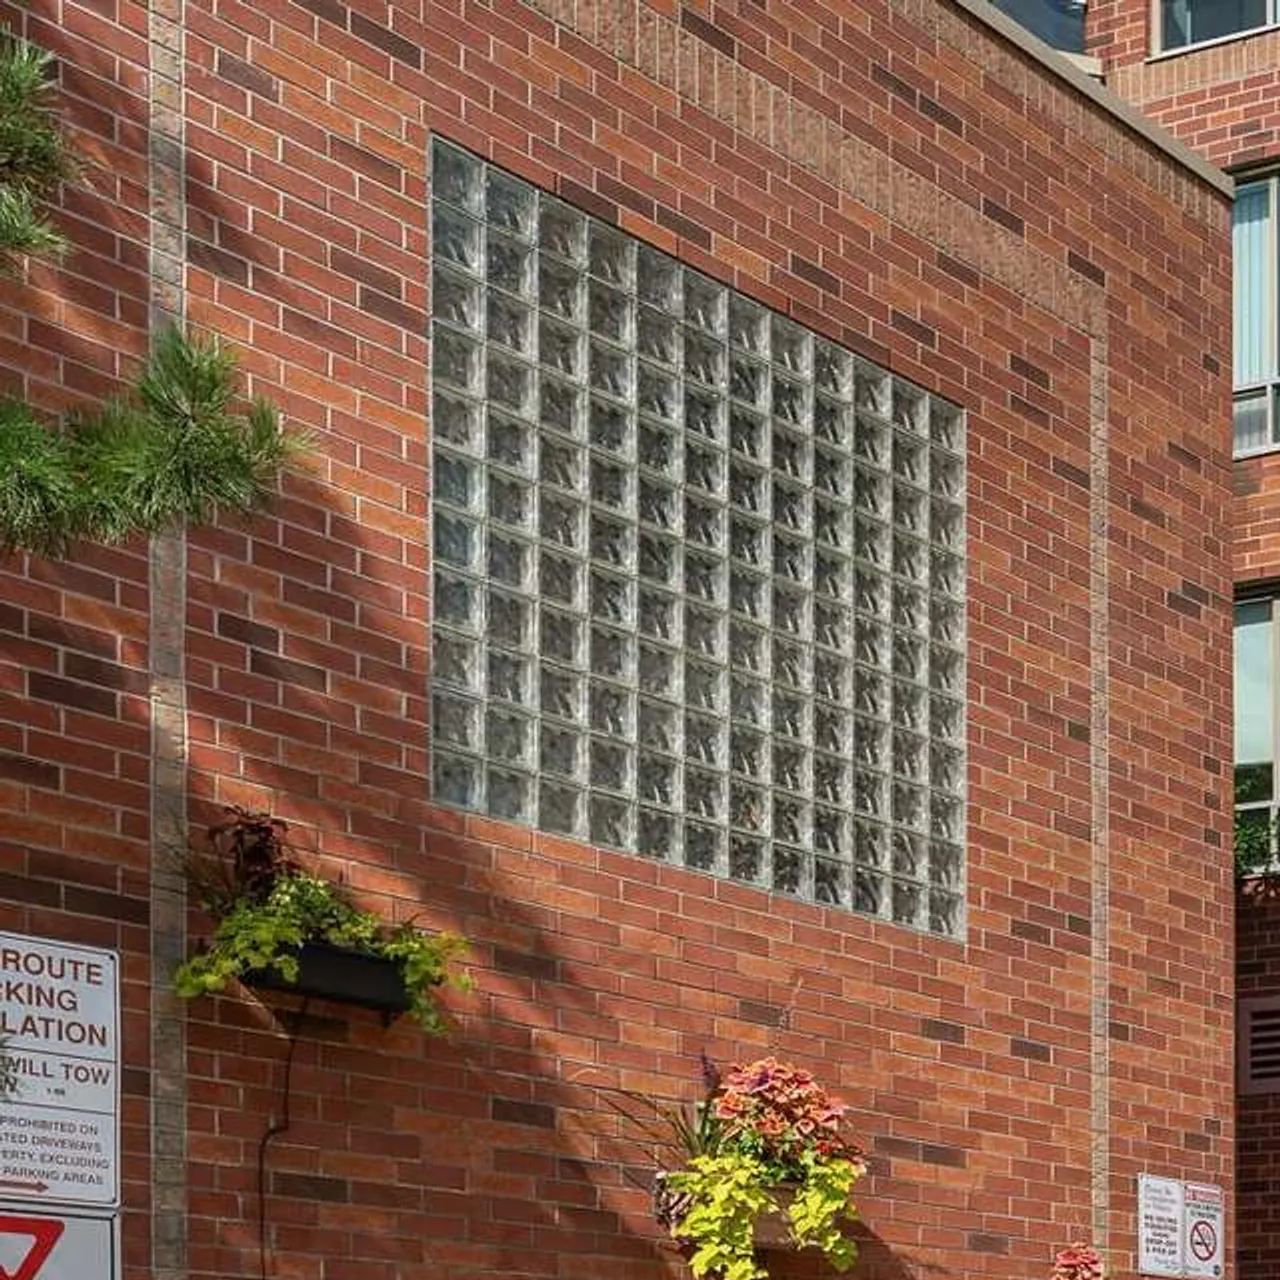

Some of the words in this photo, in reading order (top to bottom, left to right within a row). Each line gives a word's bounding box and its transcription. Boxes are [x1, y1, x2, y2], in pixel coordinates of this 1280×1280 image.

[1, 947, 103, 986] ROUTE
[0, 980, 79, 1012] KING
[61, 1062, 111, 1086] TOW
[3, 1165, 60, 1181] PARKING
